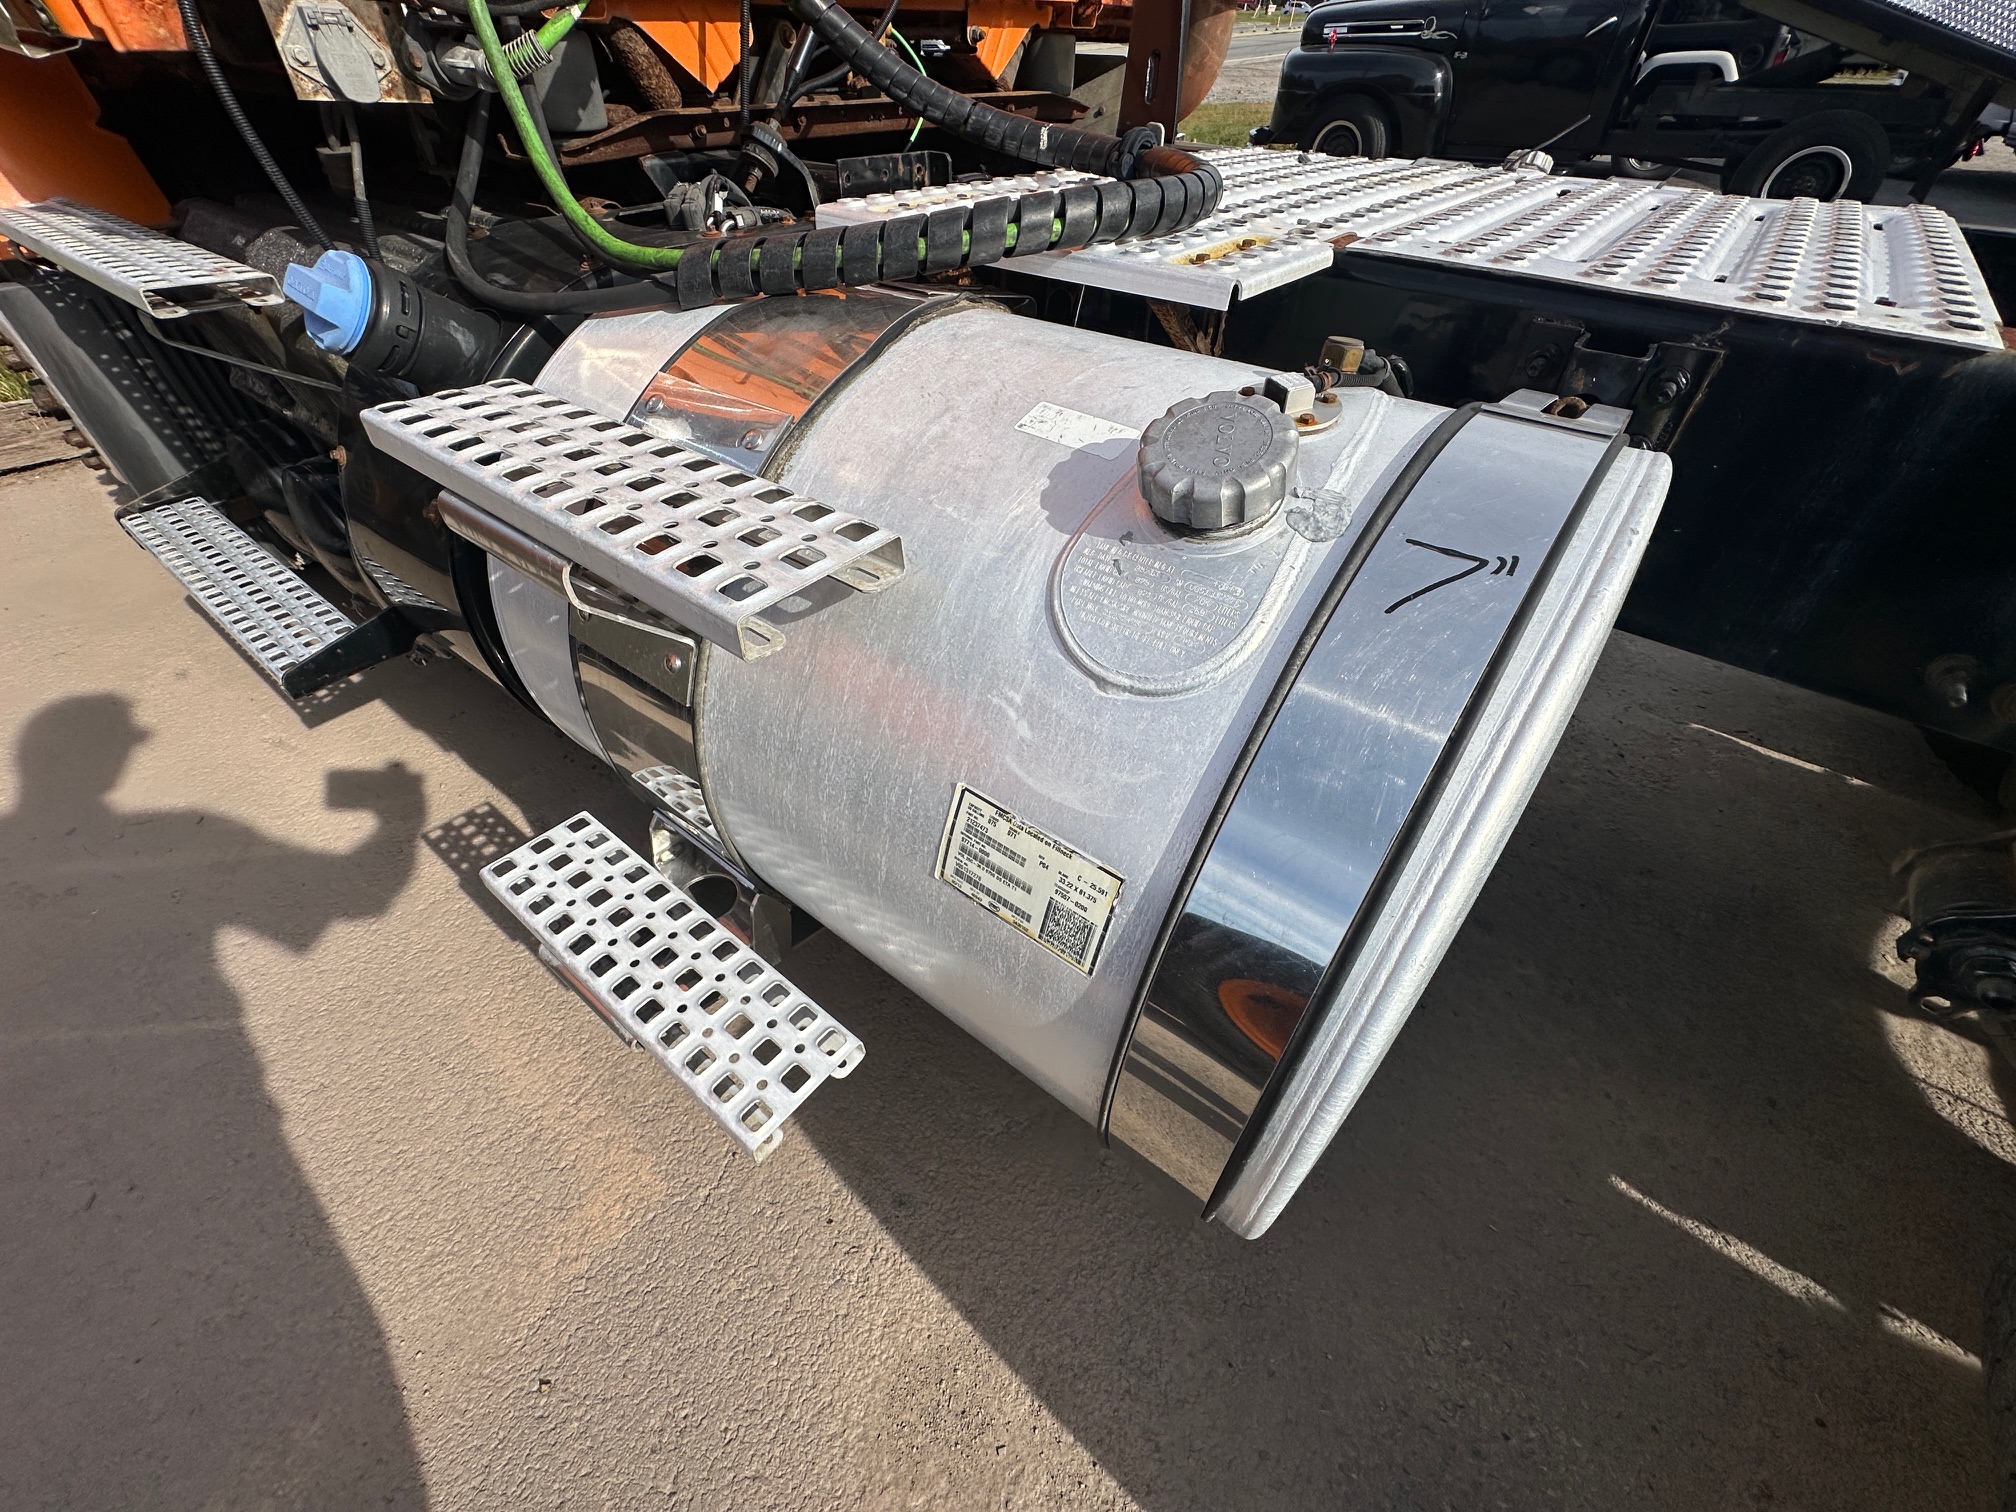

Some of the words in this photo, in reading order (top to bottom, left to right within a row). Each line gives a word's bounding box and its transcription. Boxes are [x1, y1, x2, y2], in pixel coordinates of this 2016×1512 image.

[1212, 412, 1238, 468] VOLVO
[967, 816, 988, 833] 21237473
[995, 810, 1012, 824] FMCSA
[1025, 828, 1044, 843] Located
[1052, 844, 1073, 860] Fillneck
[1058, 876, 1073, 889] 33.22
[1078, 888, 1097, 904] 81.375
[1089, 882, 1108, 897] 25.591
